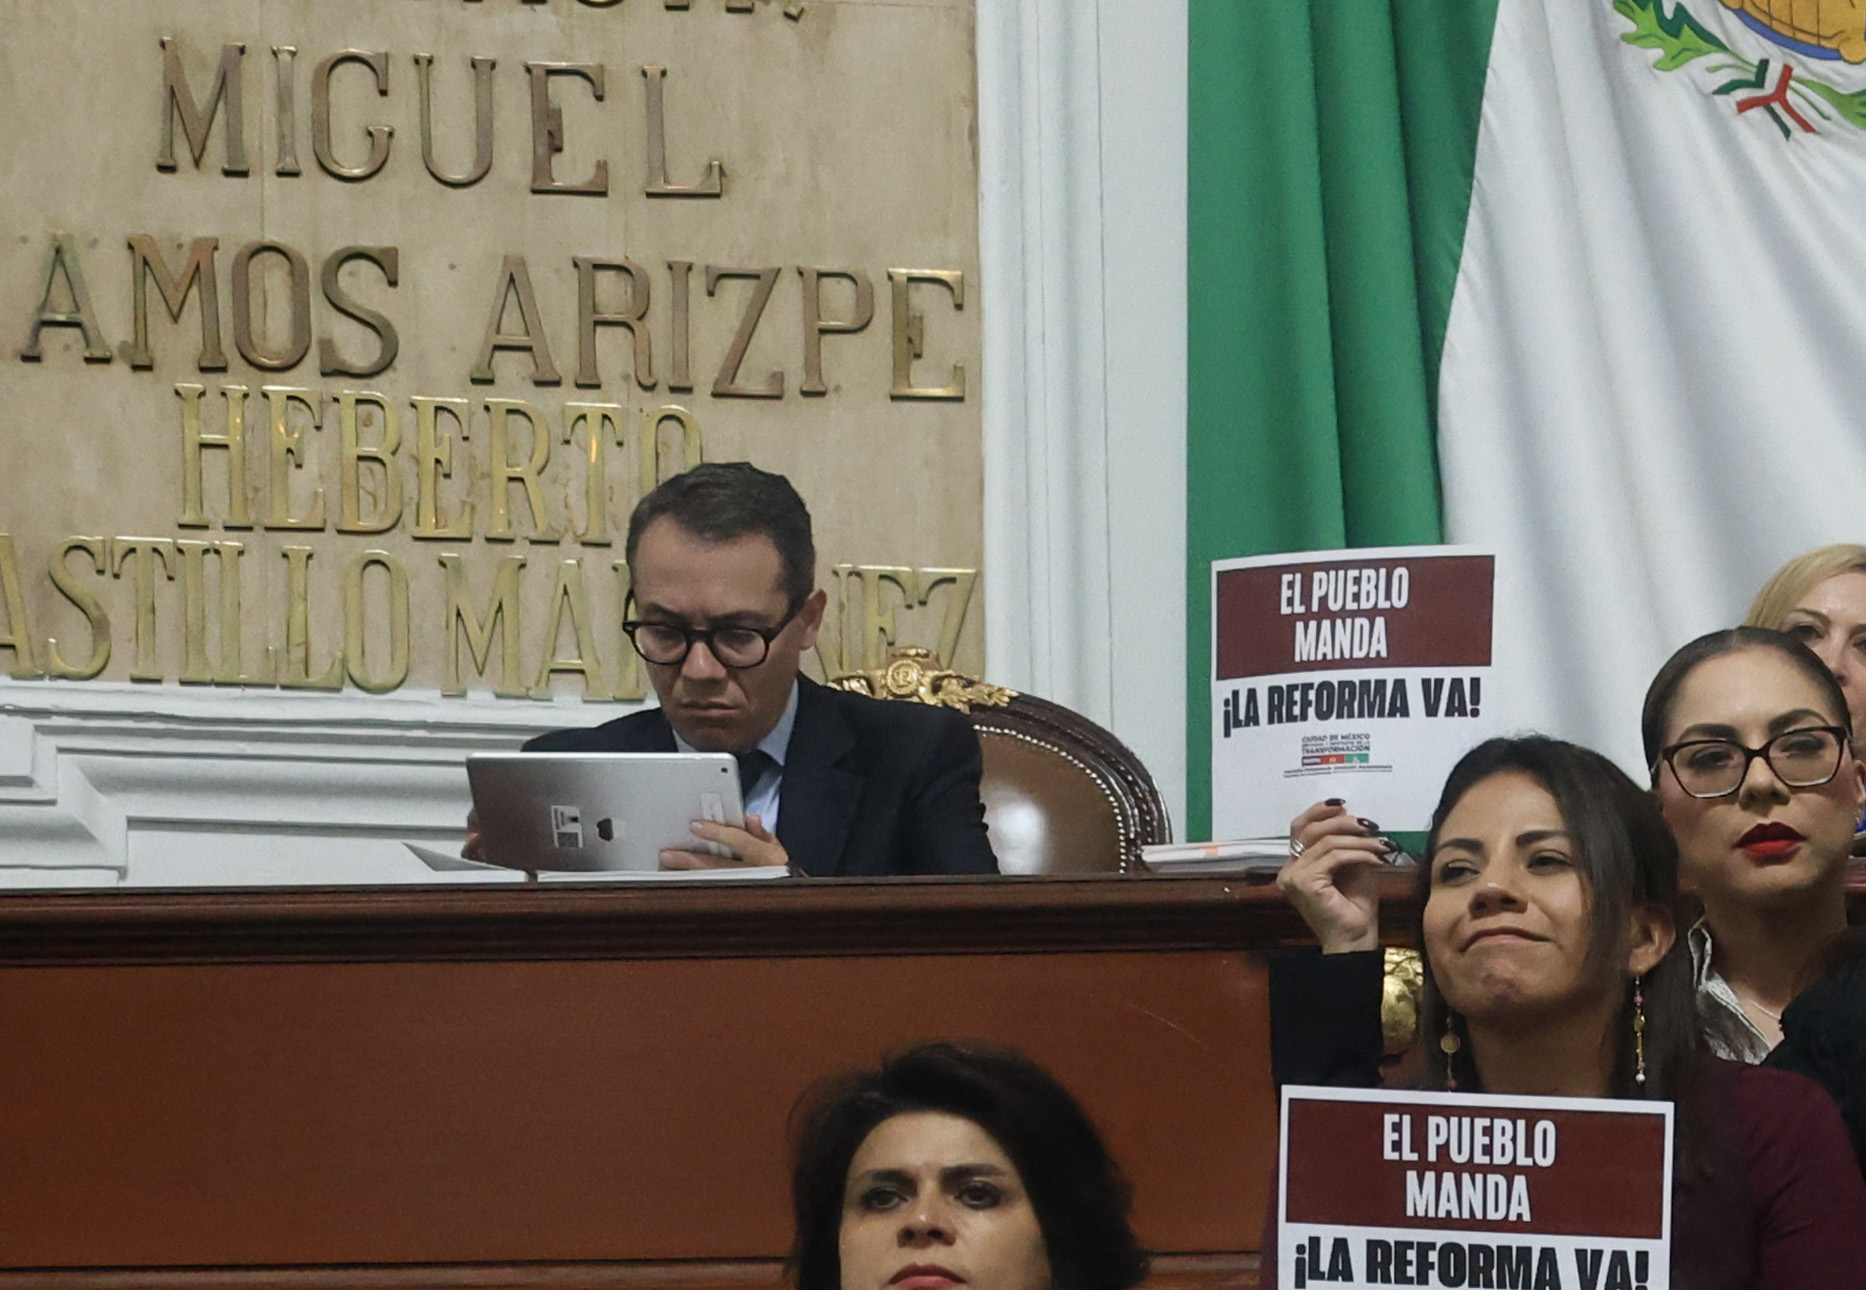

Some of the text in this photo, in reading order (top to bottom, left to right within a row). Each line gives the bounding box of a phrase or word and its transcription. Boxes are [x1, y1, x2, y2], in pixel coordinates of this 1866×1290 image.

[156, 37, 725, 197] MIGUEL
[470, 254, 966, 400] ARIZPE
[1280, 567, 1409, 615] EL PUEBLO
[1294, 619, 1388, 663] MANDA
[1224, 677, 1480, 738] ¡LA REFORMA VA!
[1384, 1114, 1555, 1167] EL PUEBLO
[1407, 1171, 1530, 1221] MANDA
[1295, 1236, 1353, 1289] ¡LA
